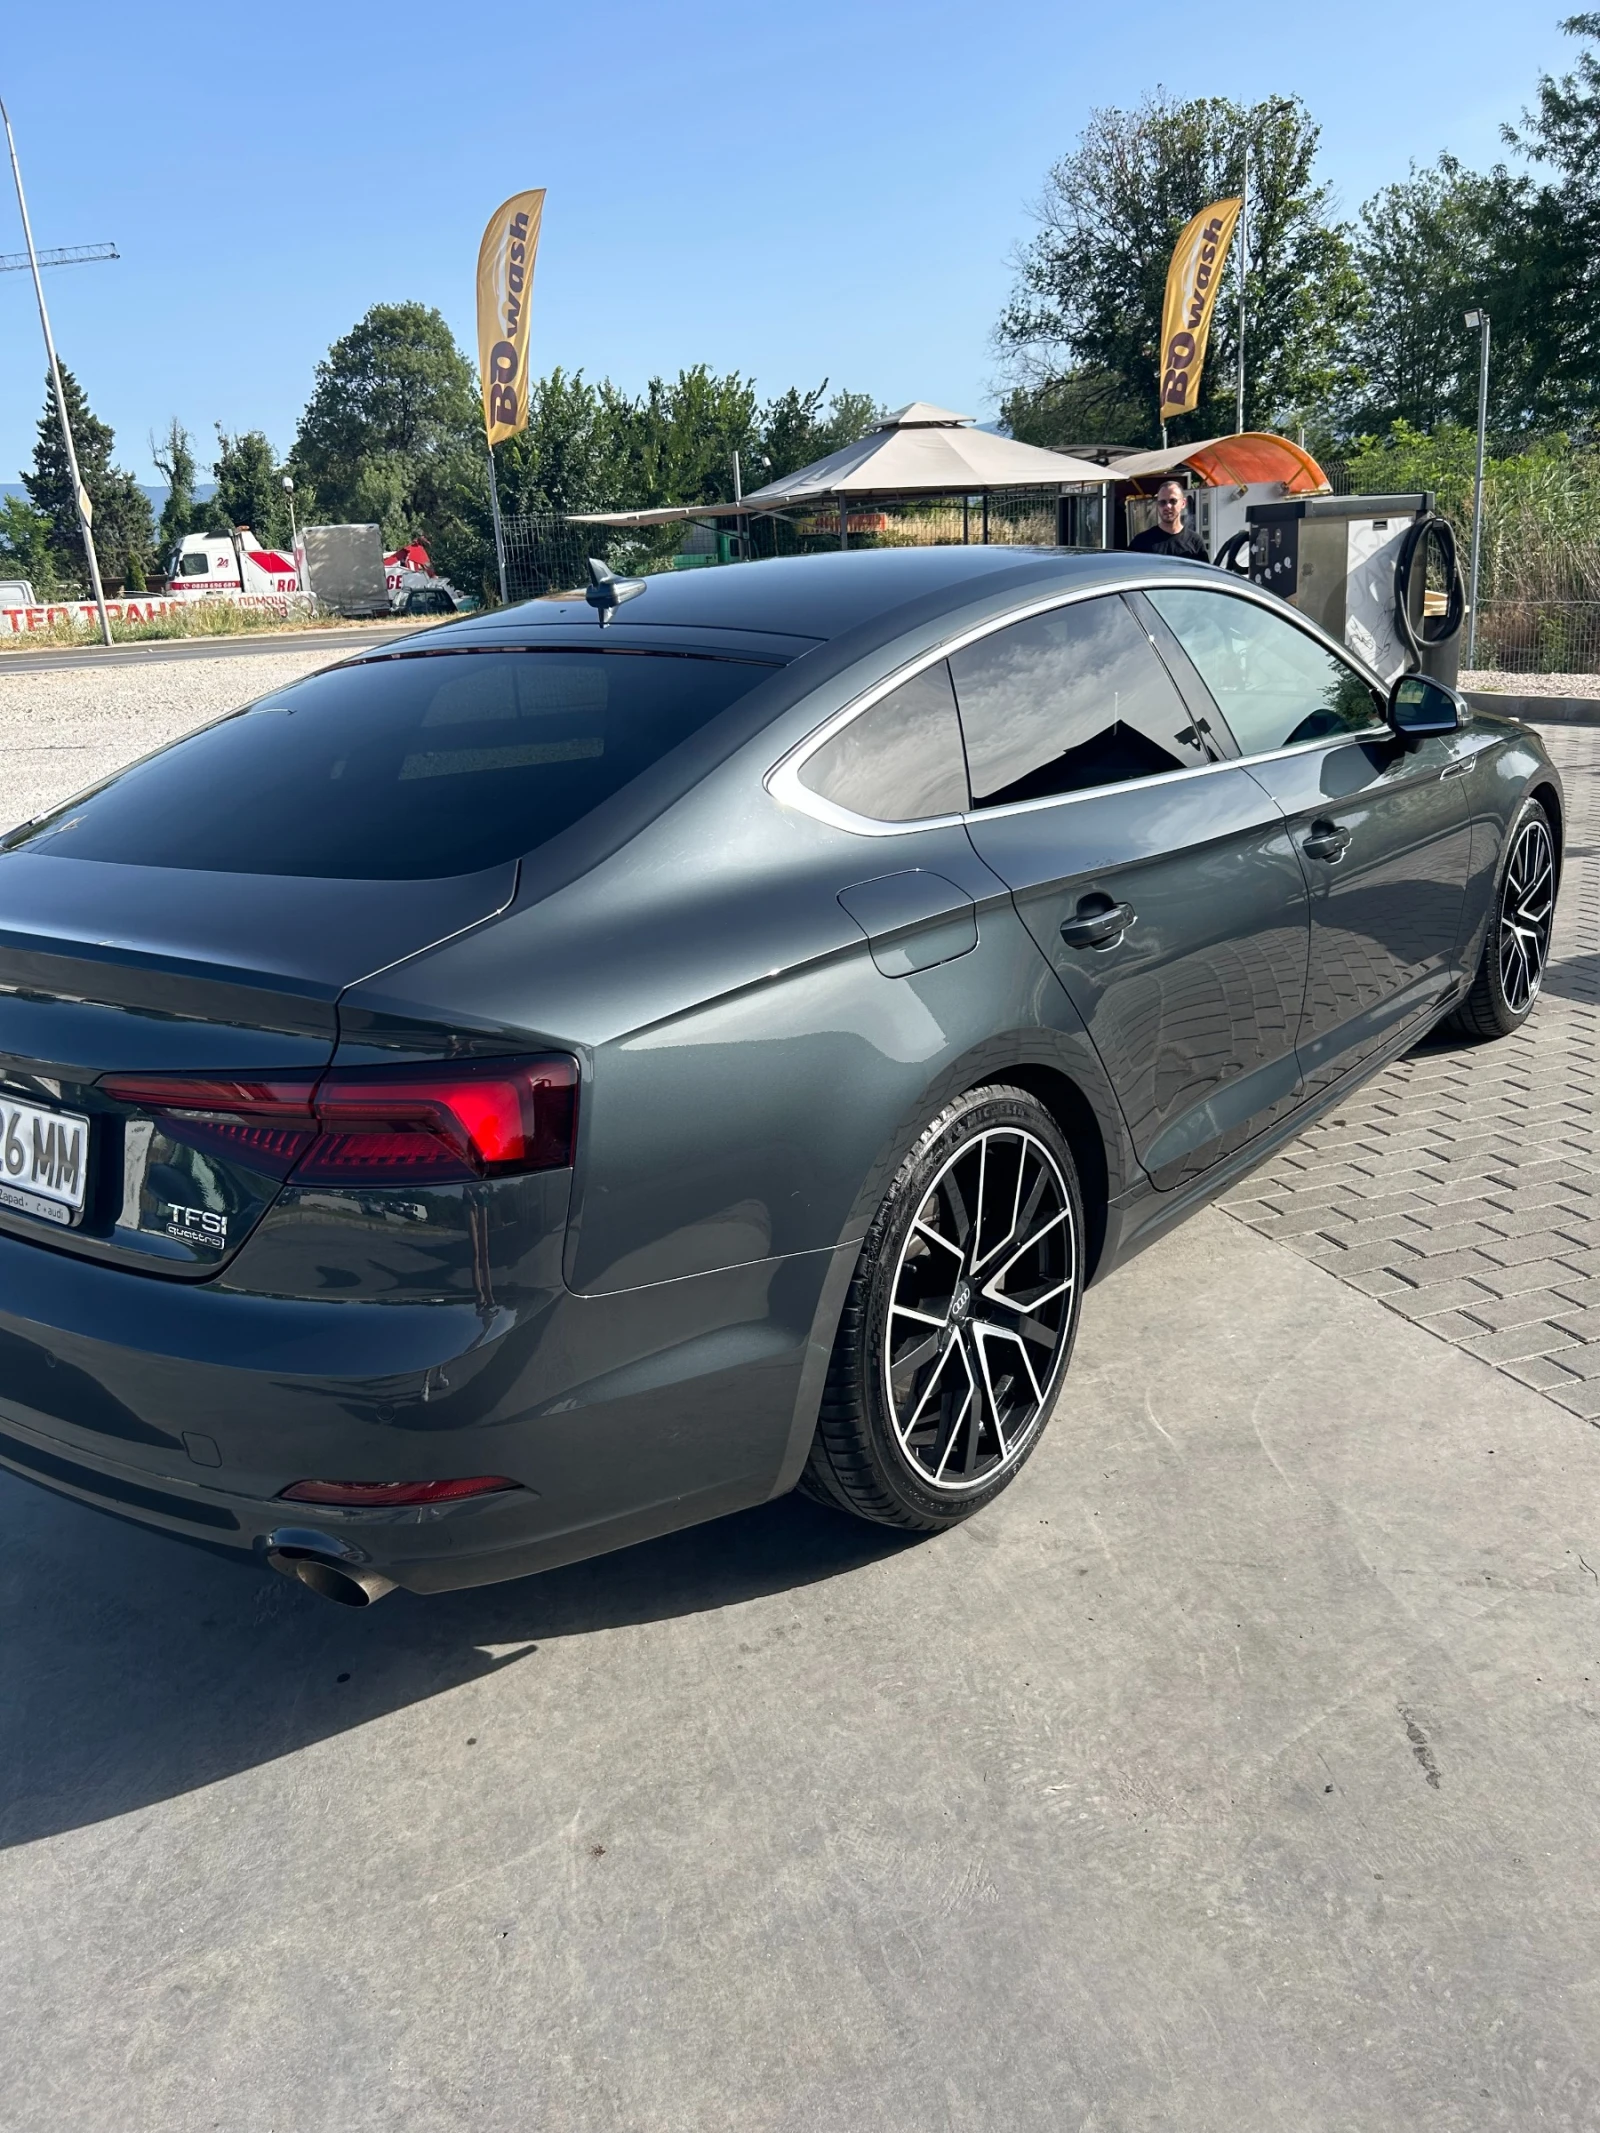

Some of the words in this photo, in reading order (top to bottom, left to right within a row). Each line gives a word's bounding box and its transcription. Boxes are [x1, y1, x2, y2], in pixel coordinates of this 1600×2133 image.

[490, 341, 519, 429] BO
[507, 211, 530, 338] wash
[1161, 331, 1196, 408] BO
[1188, 217, 1224, 330] wash
[0, 1107, 24, 1176] 6
[32, 1118, 80, 1195] MM
[168, 1203, 228, 1236] TFSI
[168, 1226, 220, 1246] quattro
